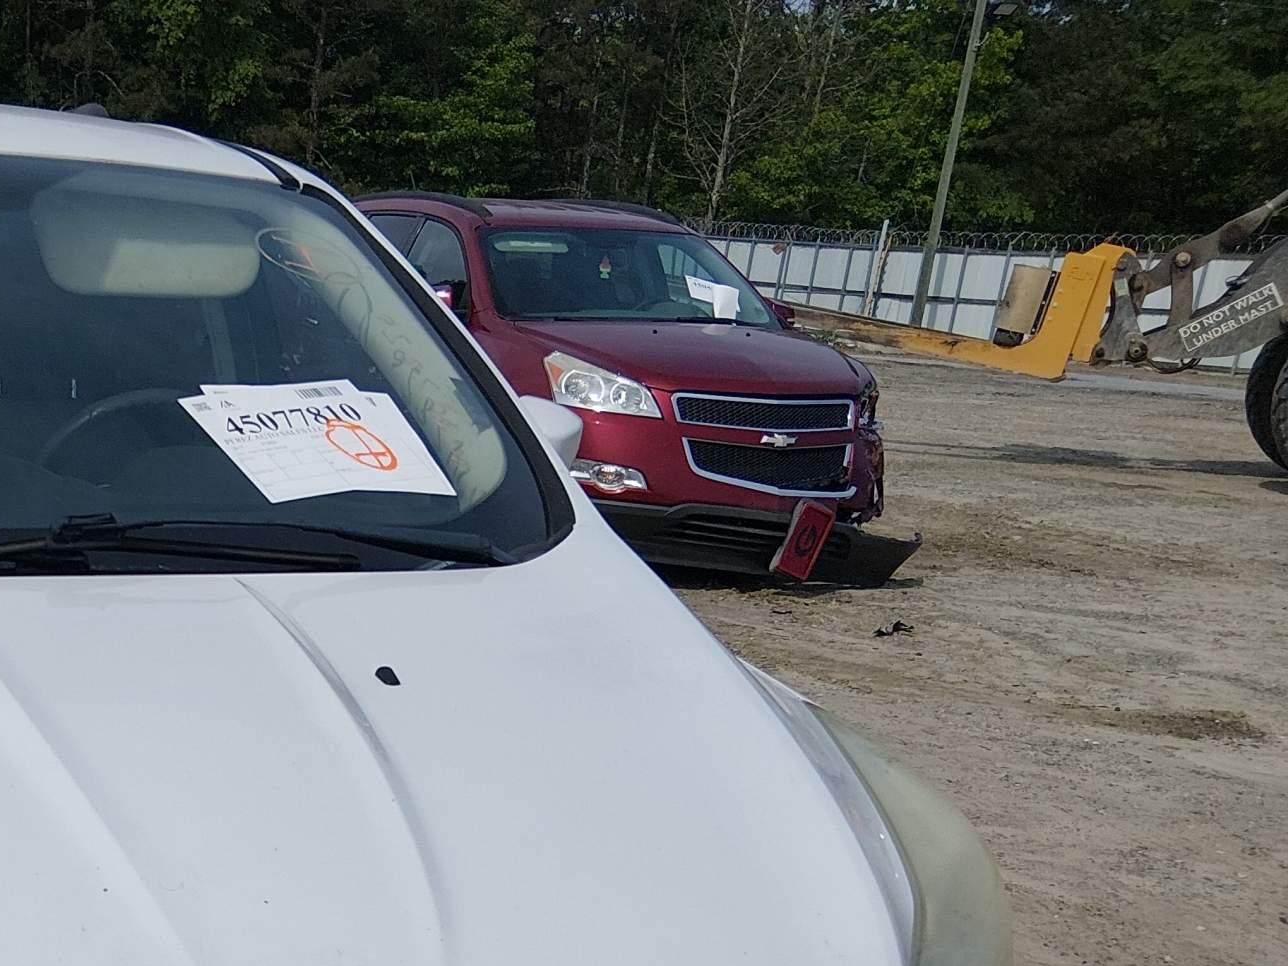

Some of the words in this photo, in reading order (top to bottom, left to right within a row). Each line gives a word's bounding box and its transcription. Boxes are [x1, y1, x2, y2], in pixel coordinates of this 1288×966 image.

[1179, 322, 1201, 338] DO
[1202, 306, 1231, 327] NOT
[1234, 287, 1274, 311] WALK
[1192, 320, 1238, 346] UNDER
[1238, 300, 1274, 325] MAST
[226, 403, 362, 435] 45077810
